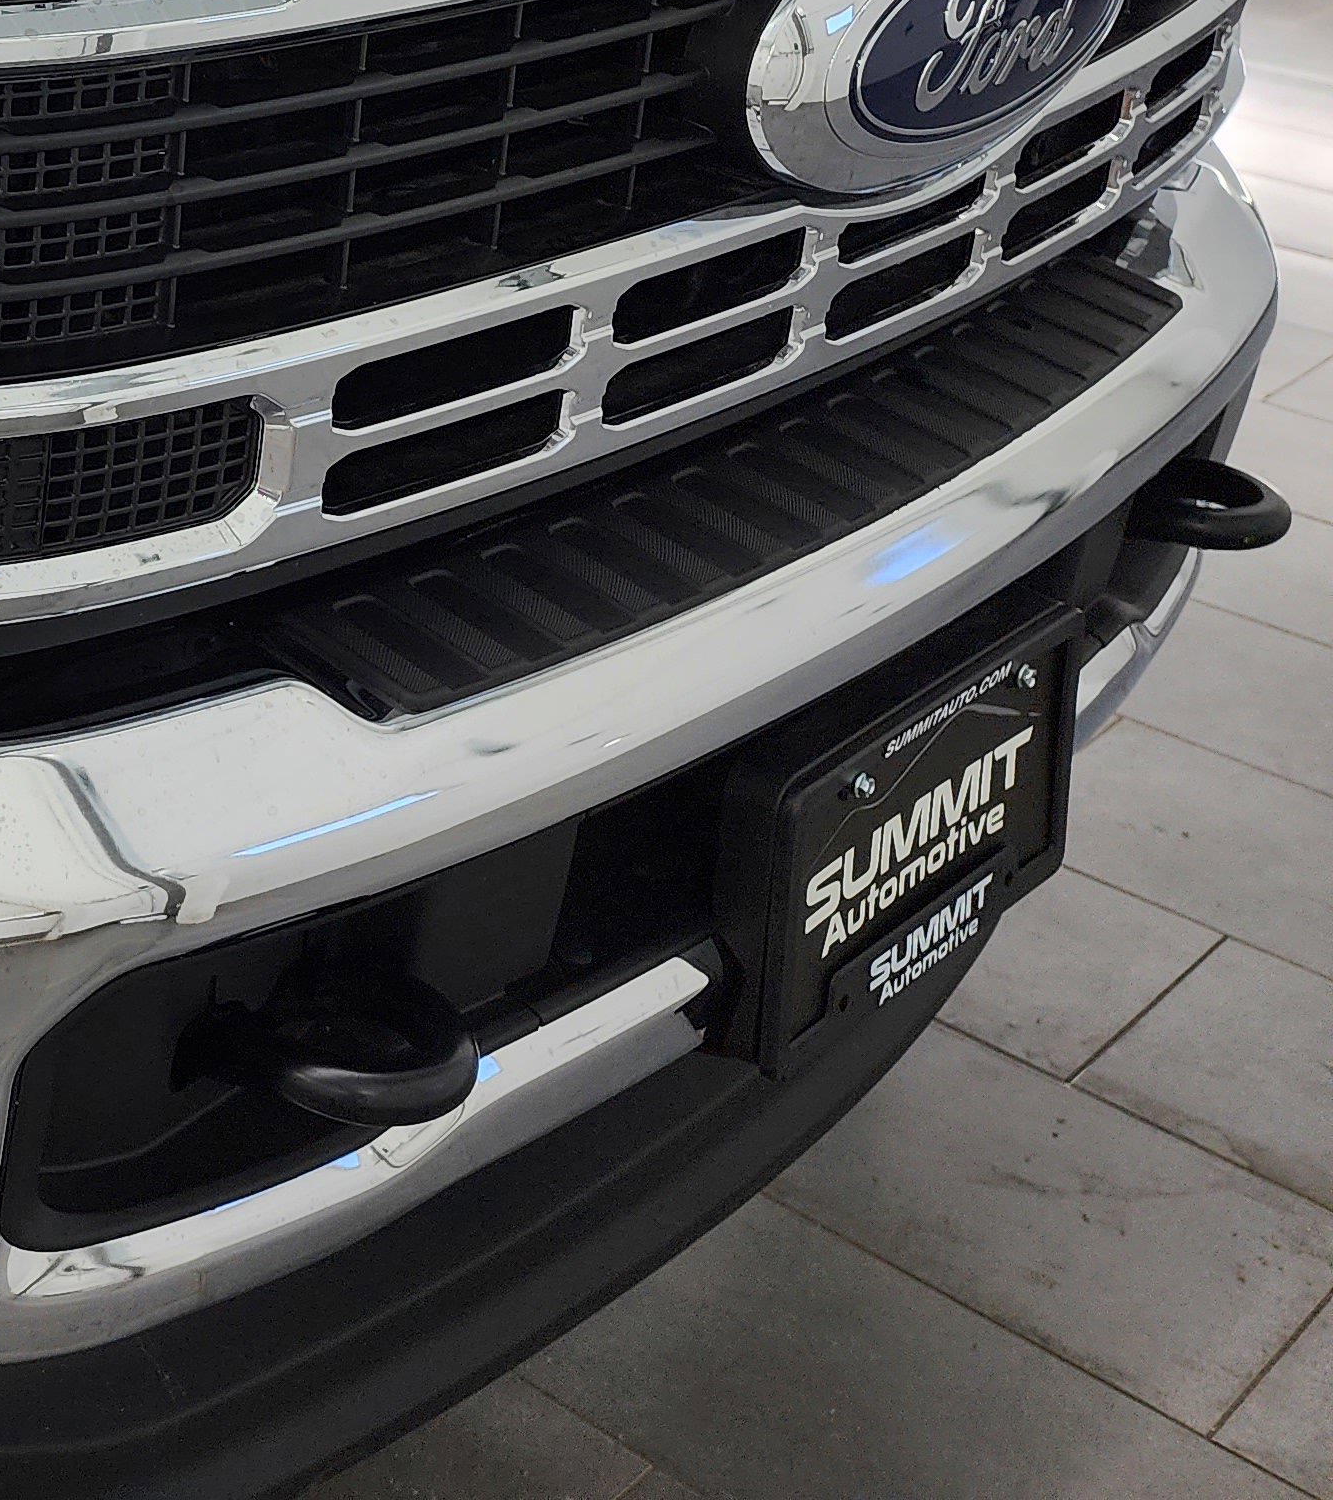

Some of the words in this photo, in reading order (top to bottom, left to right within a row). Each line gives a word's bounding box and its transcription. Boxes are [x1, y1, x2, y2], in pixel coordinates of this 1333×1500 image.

[884, 660, 1013, 759] SUMMITAUTO.COM
[805, 725, 1033, 935] SUMMIT
[821, 802, 1005, 960] Automotive
[870, 872, 993, 992] SUMMIT
[879, 917, 979, 1007] Automotive
